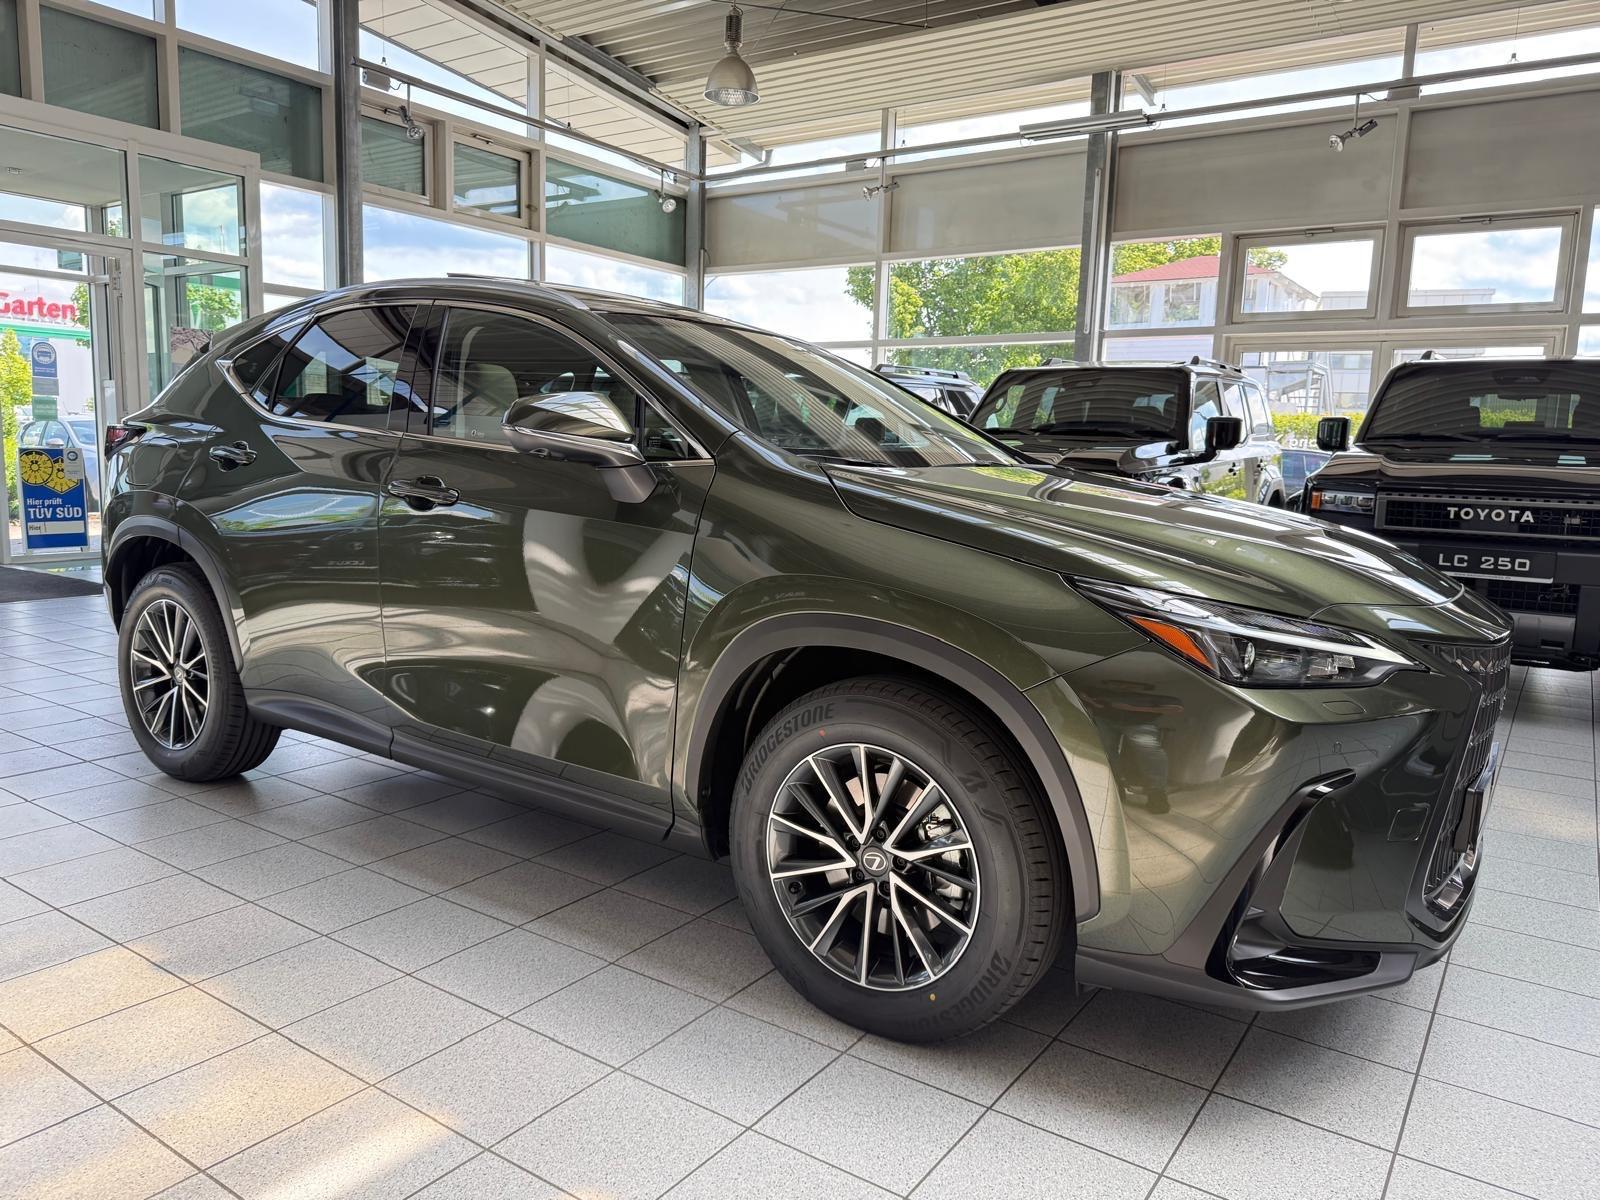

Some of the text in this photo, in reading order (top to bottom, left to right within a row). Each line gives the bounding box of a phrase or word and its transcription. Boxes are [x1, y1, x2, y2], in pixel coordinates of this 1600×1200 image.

[0, 292, 77, 320] Garten
[27, 498, 62, 507] Hier prüft
[28, 505, 82, 519] TÜV SÜD
[1447, 507, 1534, 523] TOYOTA
[1439, 553, 1530, 572] LC 250
[742, 703, 834, 796] BRIDGESTONE
